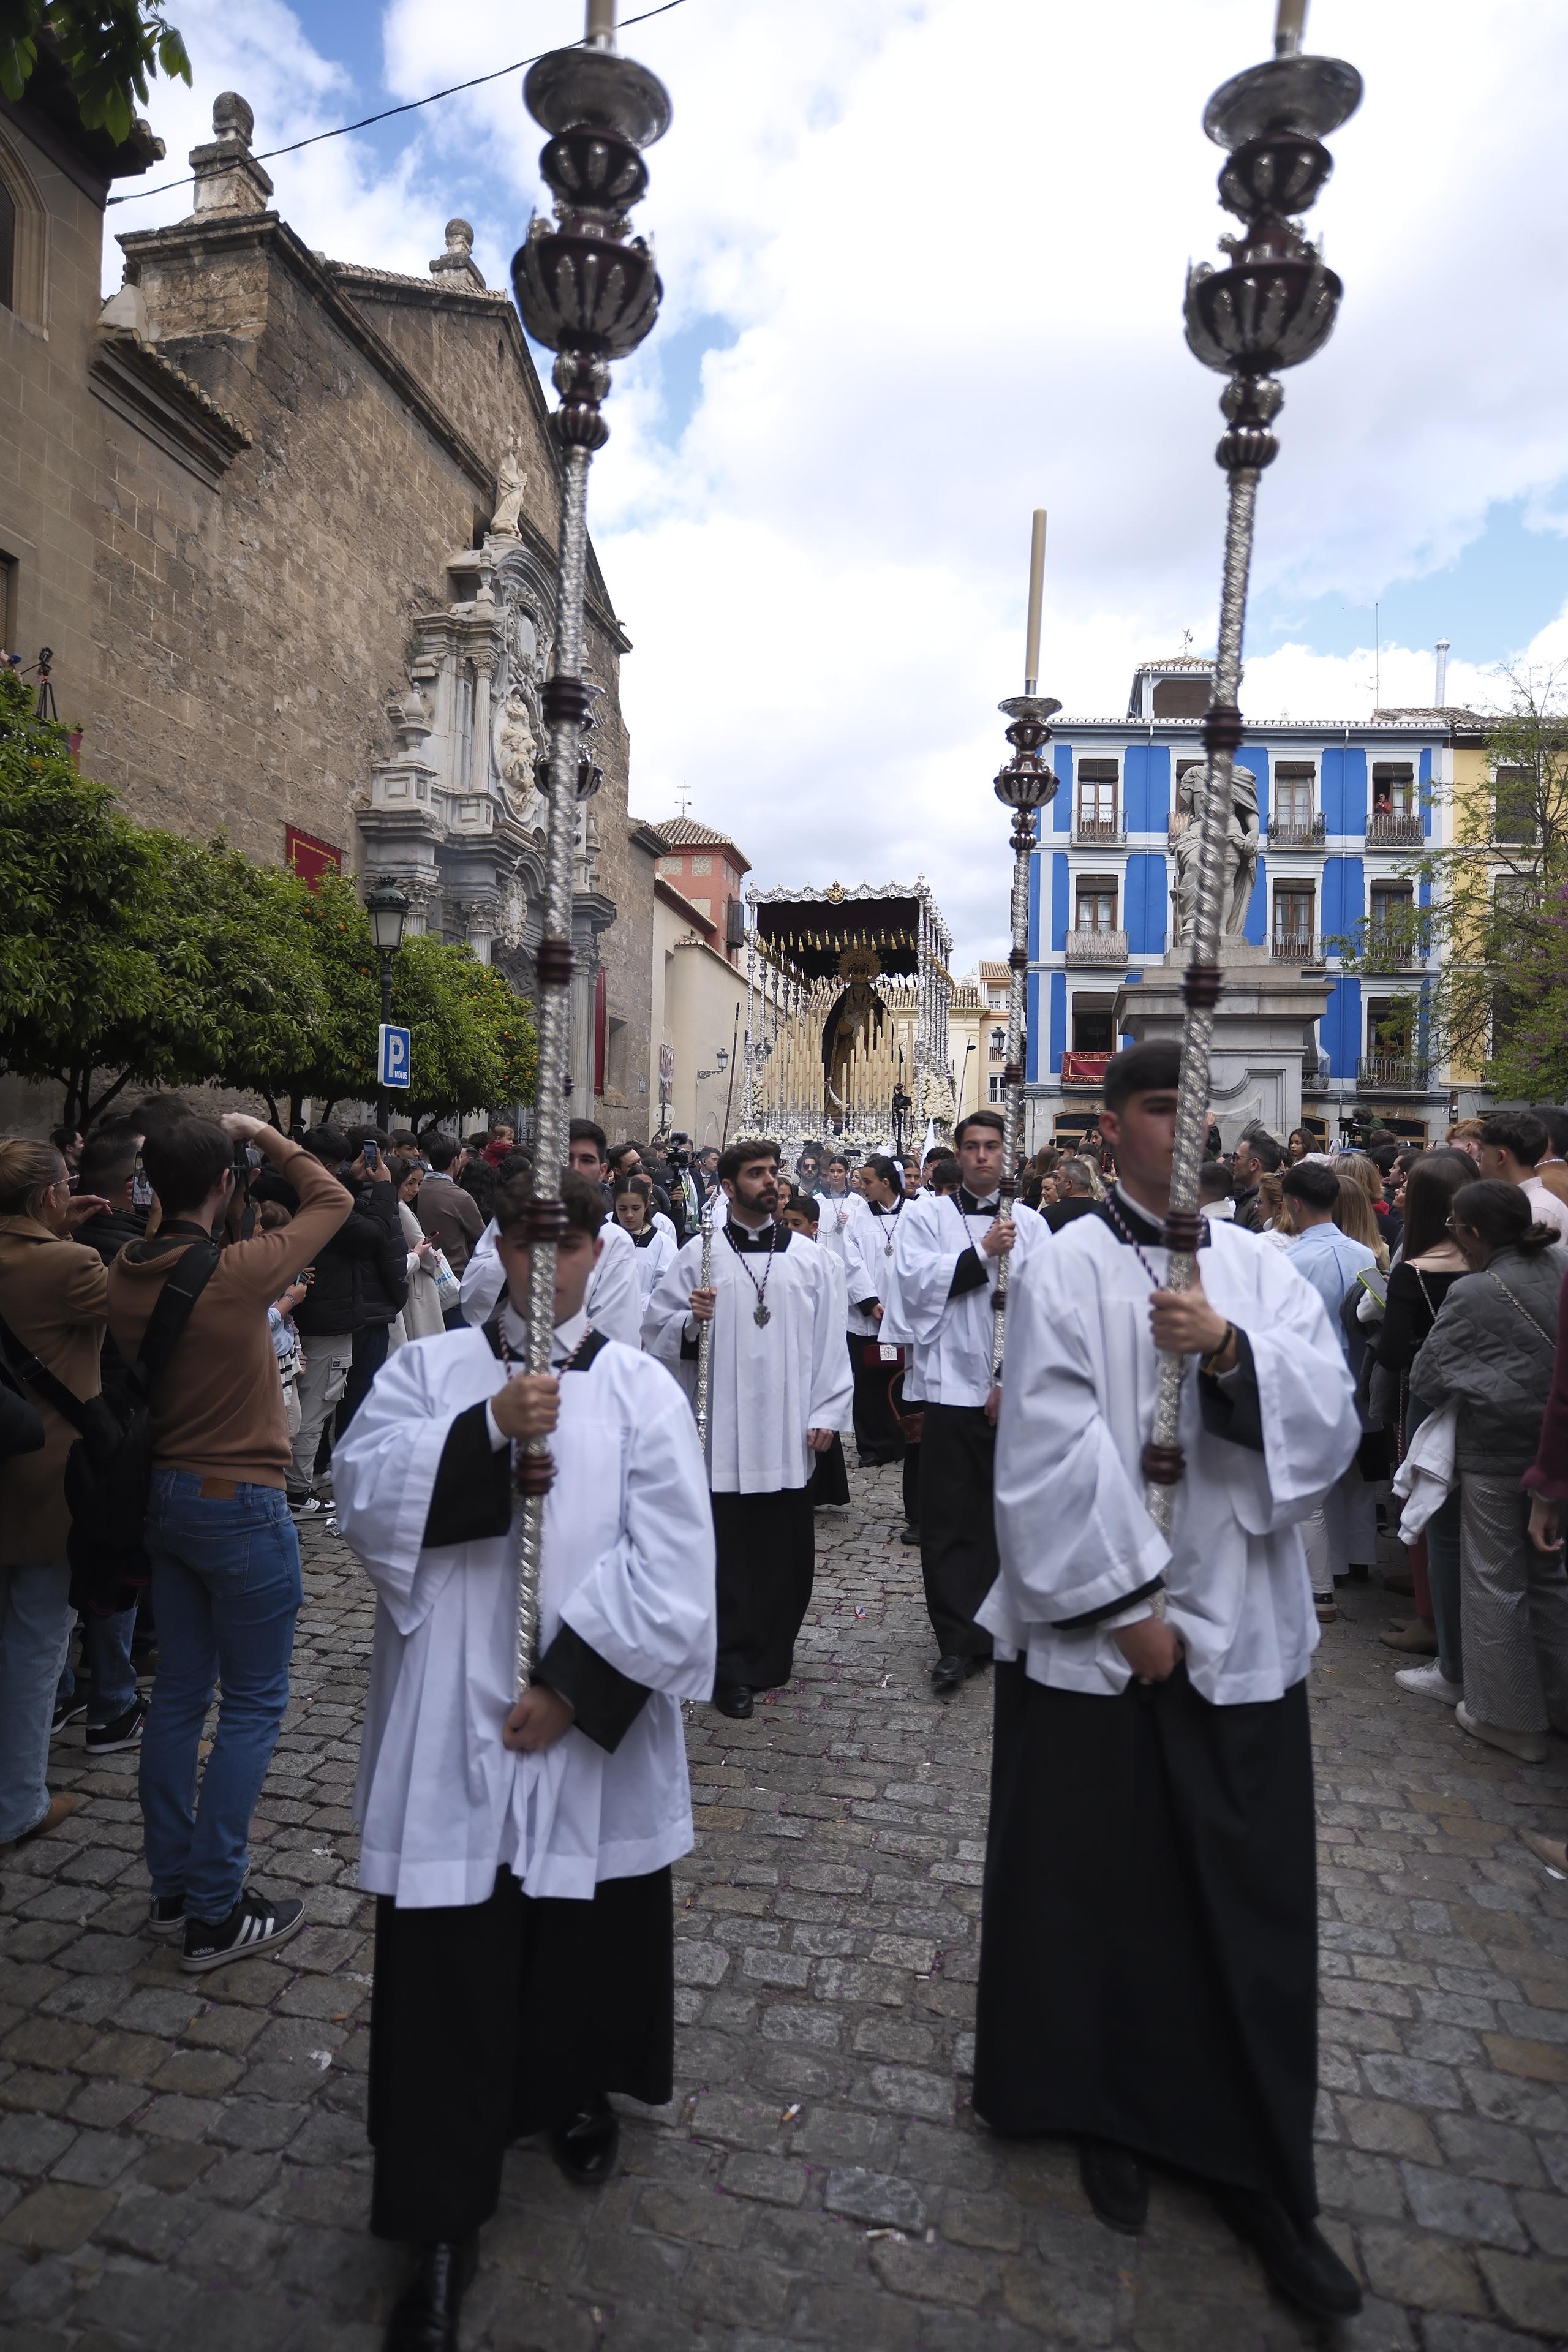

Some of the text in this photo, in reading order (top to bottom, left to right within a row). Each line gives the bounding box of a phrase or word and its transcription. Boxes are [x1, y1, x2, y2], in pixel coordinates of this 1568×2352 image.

[389, 1035, 404, 1078] P
[394, 1071, 408, 1079] MOTOS
[192, 1947, 215, 1956] adidas
